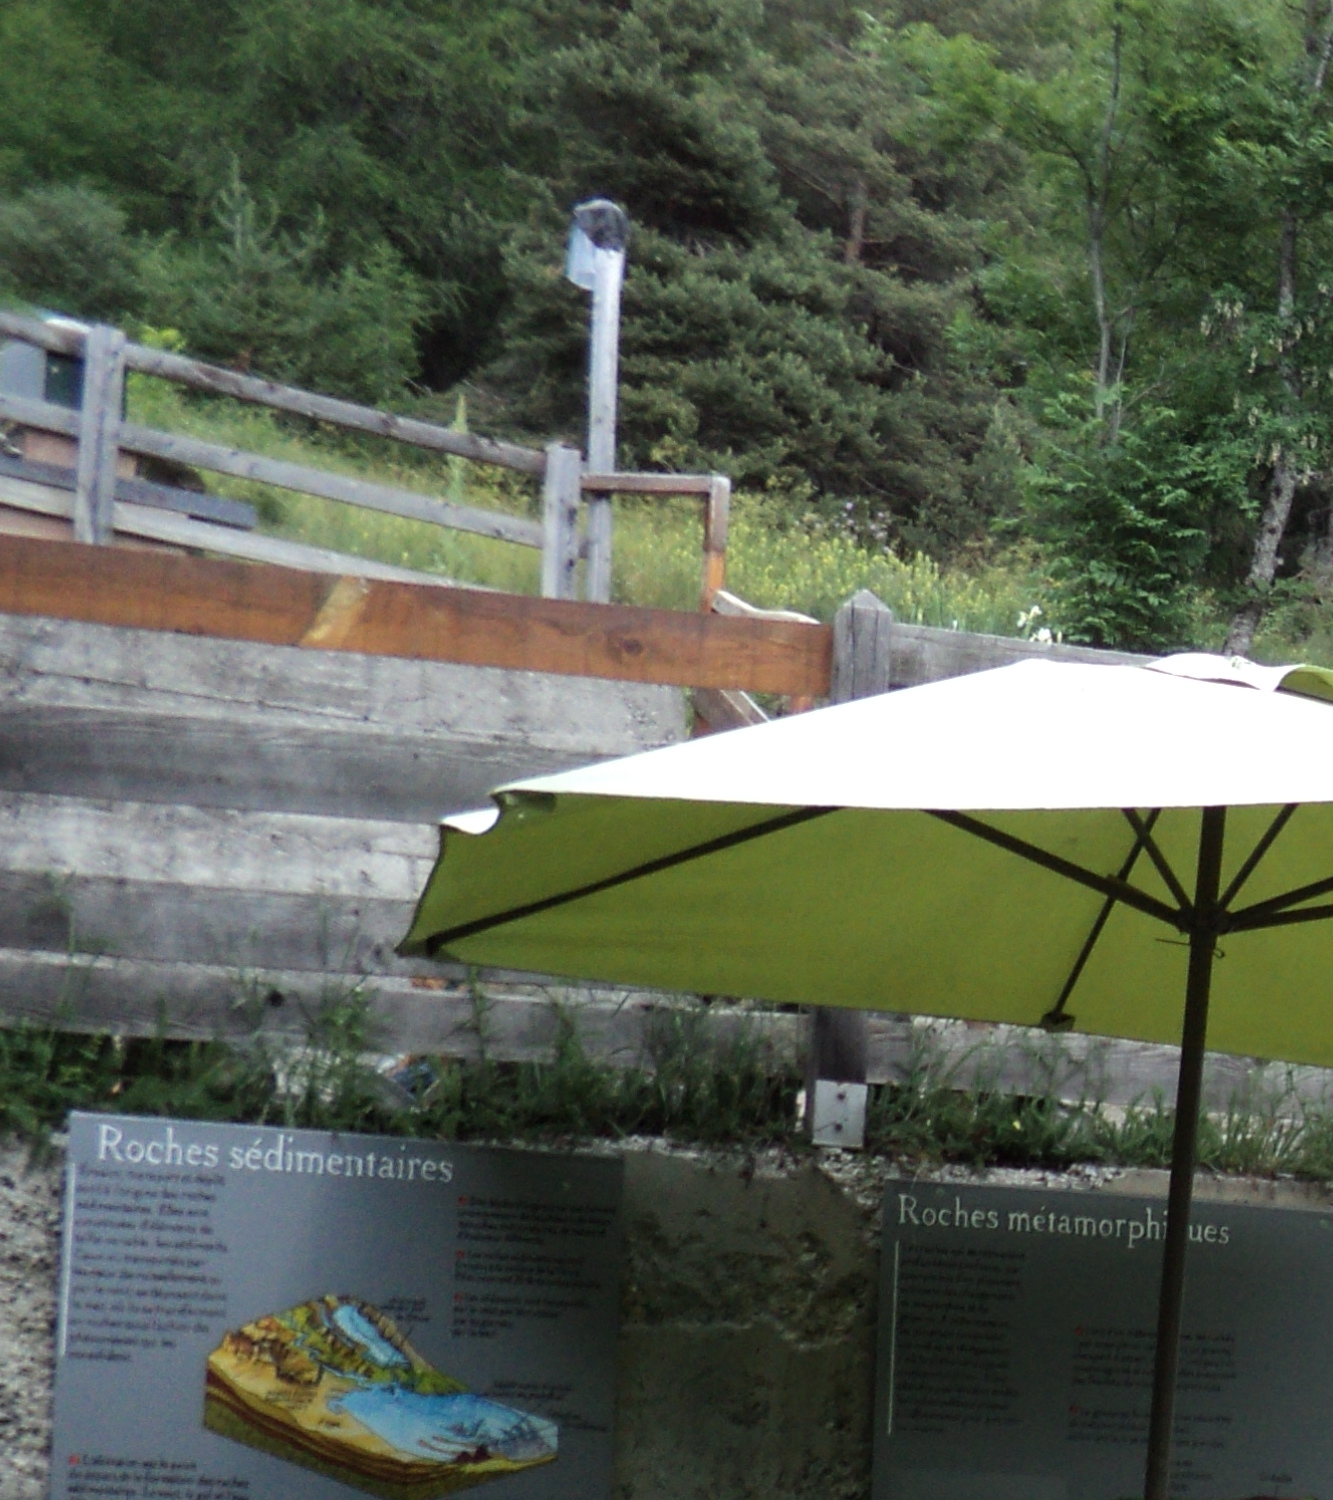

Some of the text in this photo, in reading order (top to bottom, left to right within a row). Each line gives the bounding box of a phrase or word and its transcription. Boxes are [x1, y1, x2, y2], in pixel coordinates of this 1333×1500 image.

[98, 1124, 454, 1183] Roches sédimentaires
[898, 1194, 1231, 1248] Roches métamorphiues
